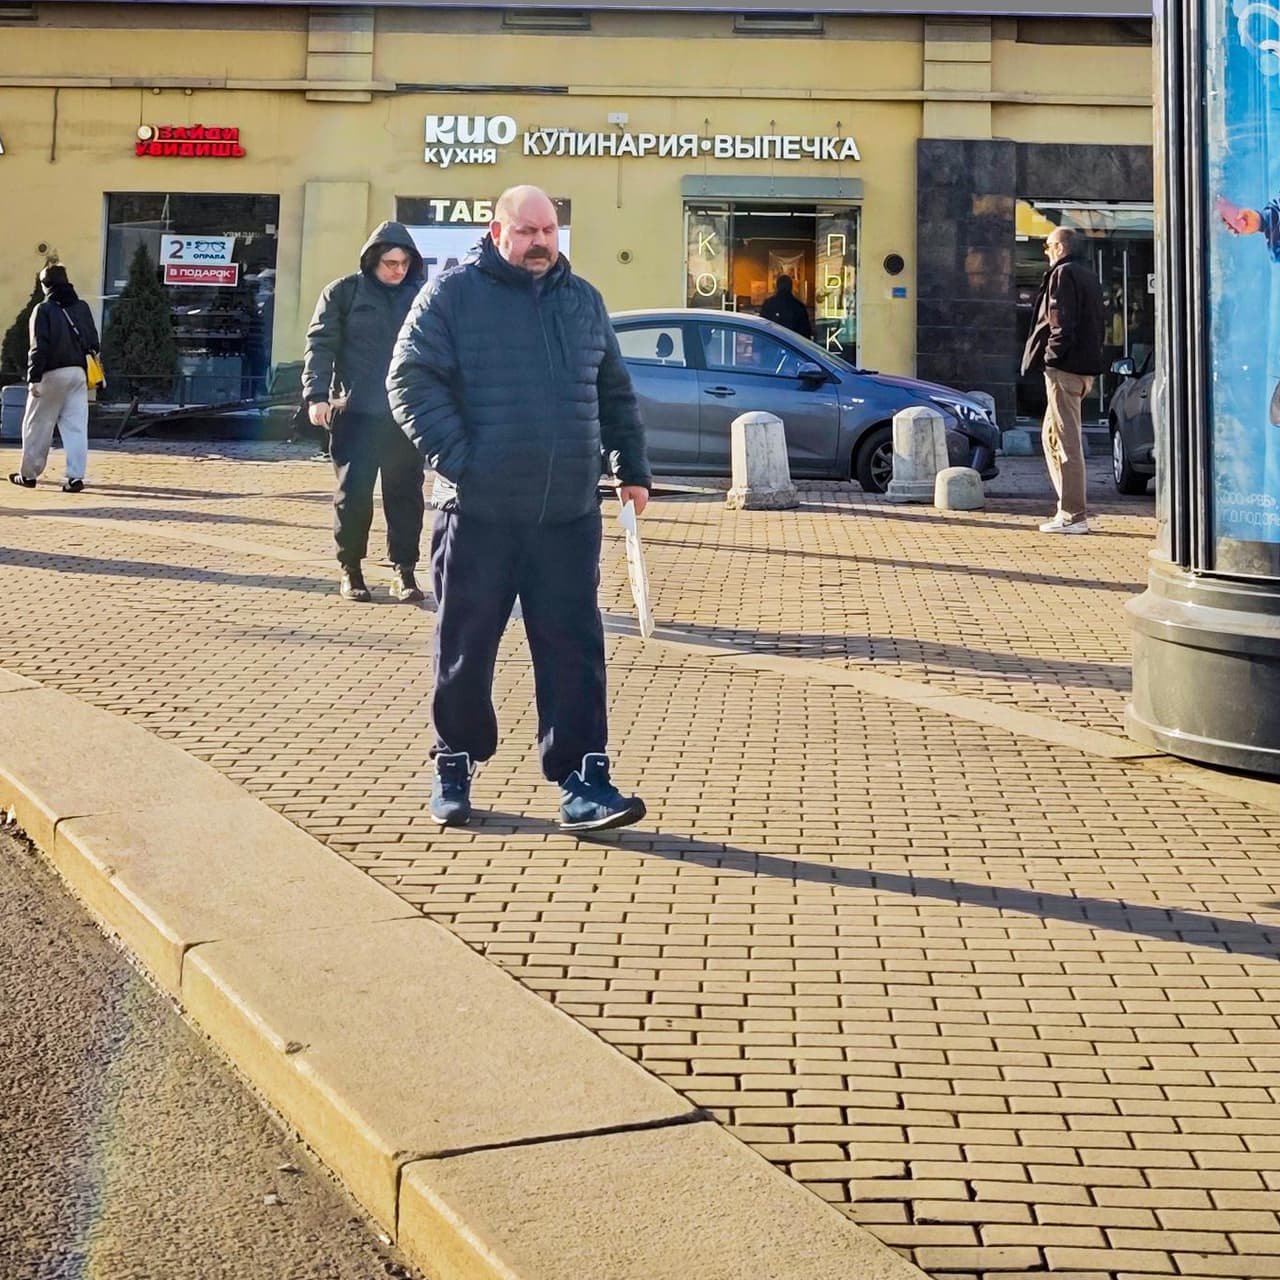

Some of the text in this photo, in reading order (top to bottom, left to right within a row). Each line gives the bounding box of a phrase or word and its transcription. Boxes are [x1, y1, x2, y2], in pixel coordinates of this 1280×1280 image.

[135, 142, 246, 158] УВИДИШЬ
[424, 147, 497, 169] кухня
[429, 199, 495, 223] ТАБ
[824, 233, 847, 354] ПЫШК
